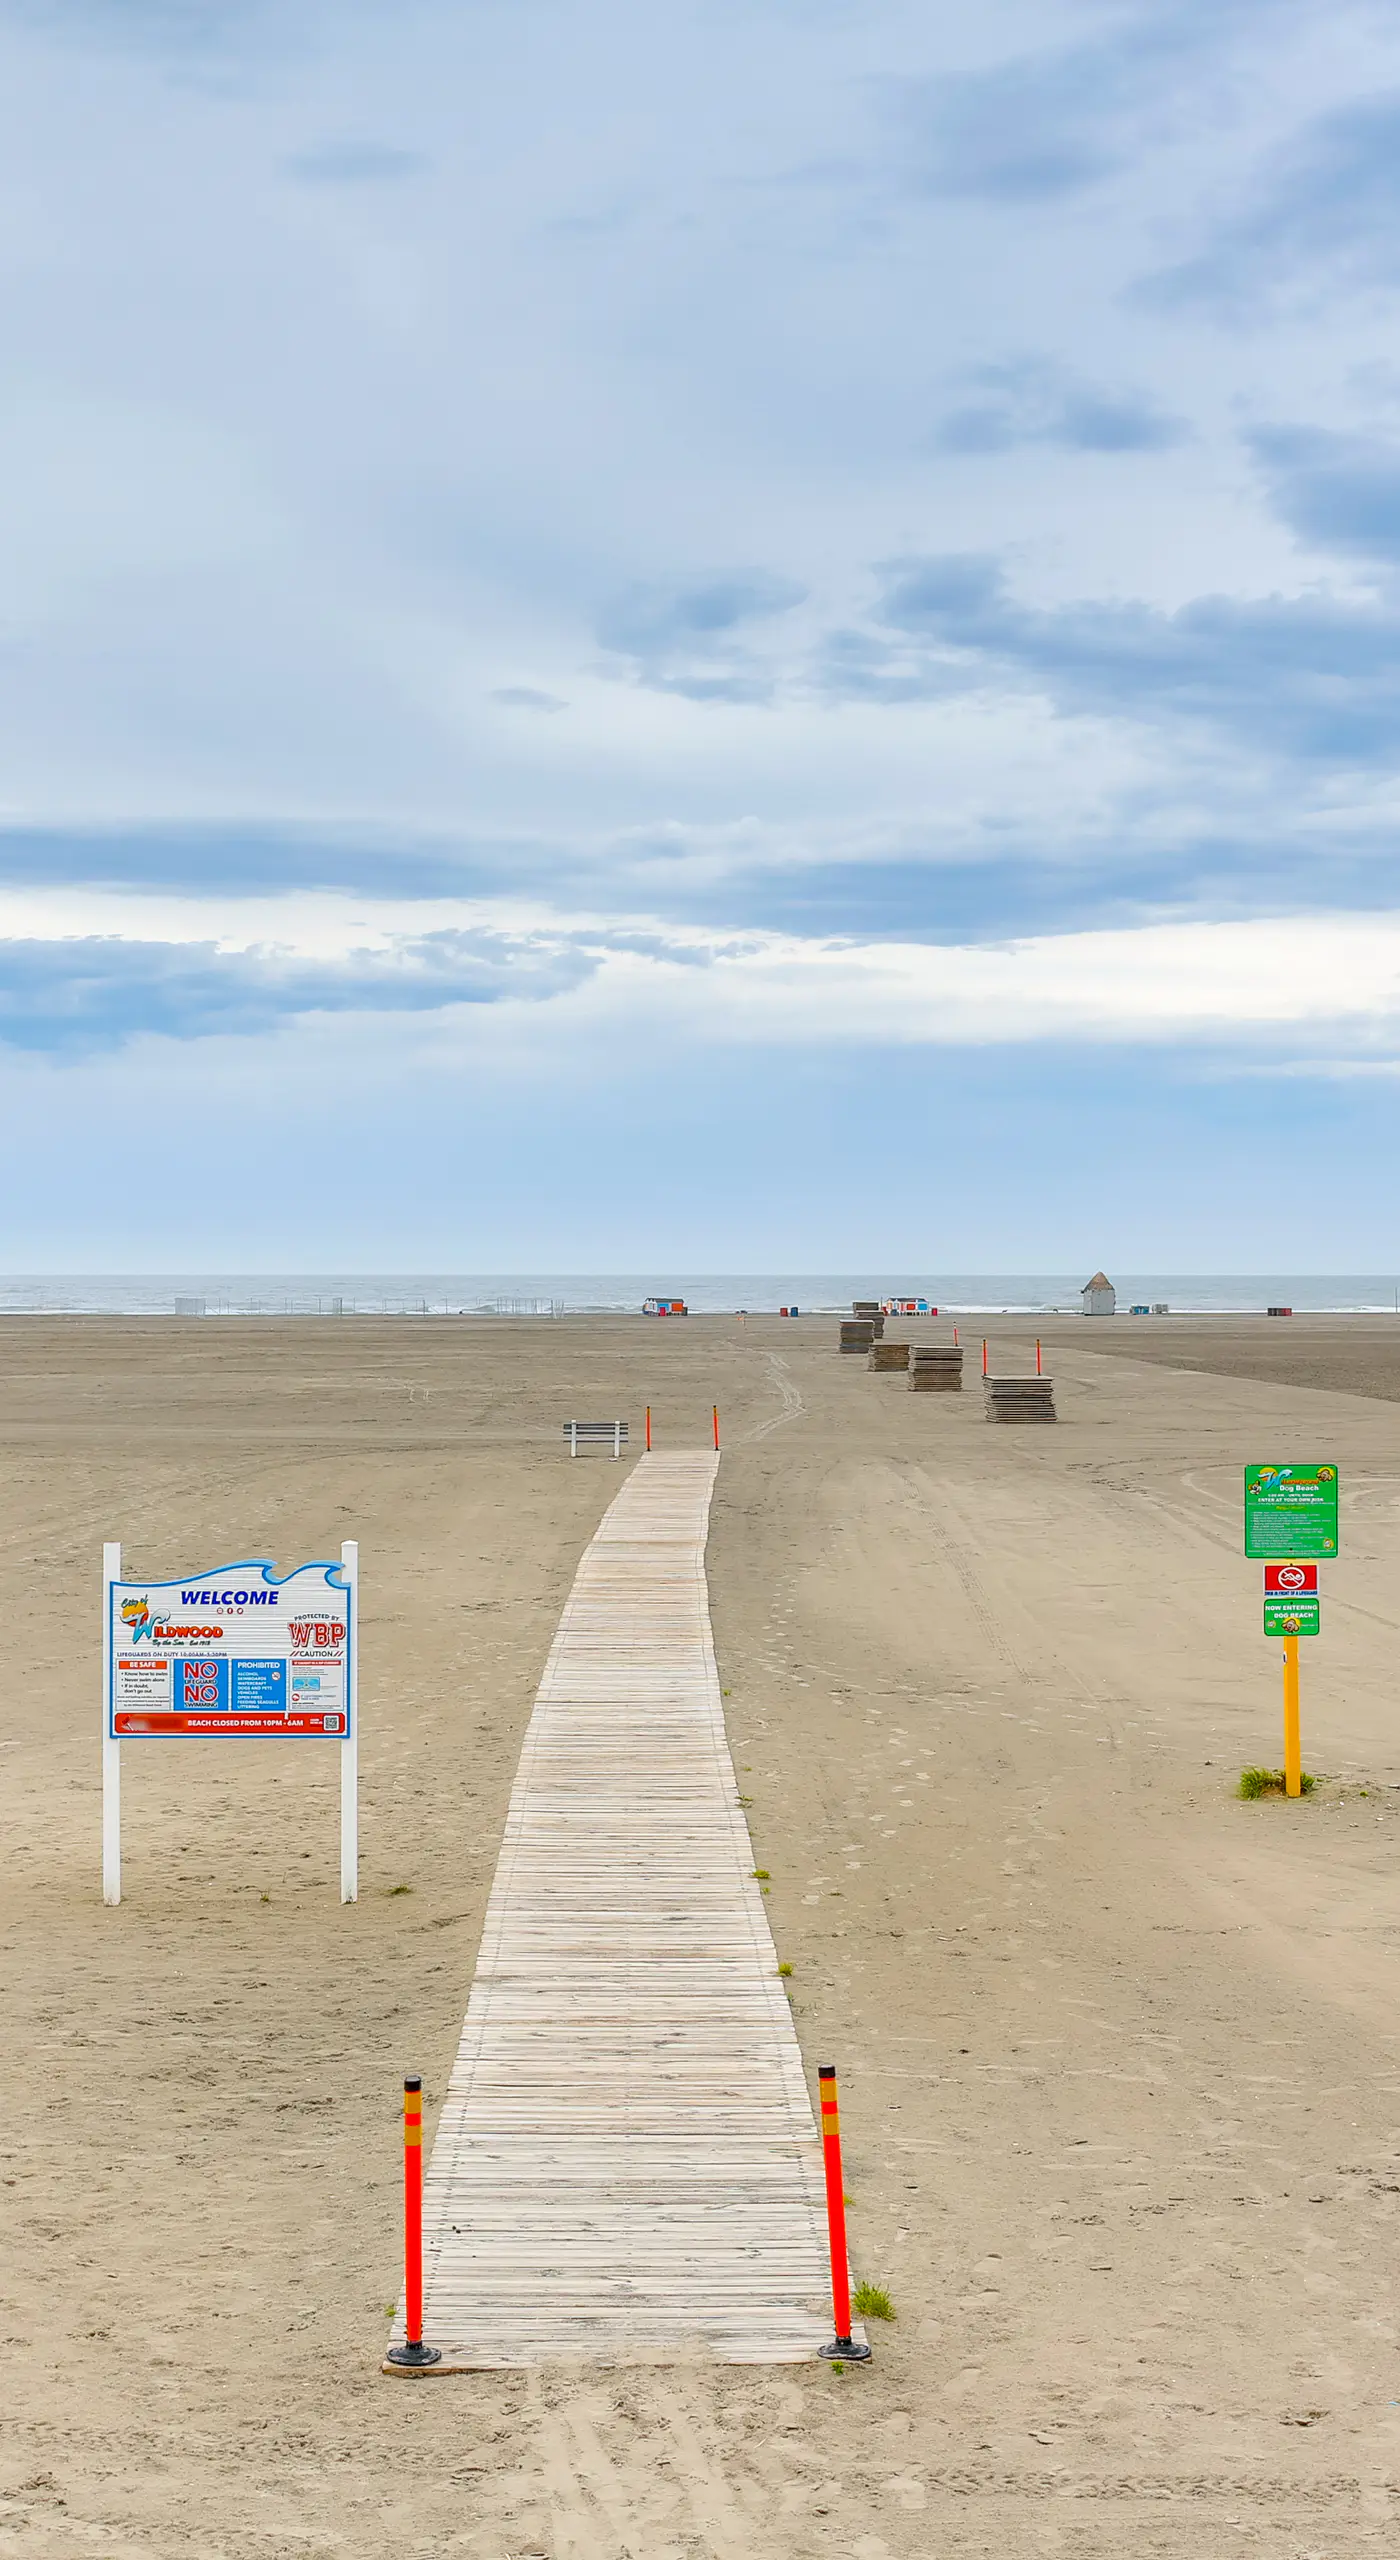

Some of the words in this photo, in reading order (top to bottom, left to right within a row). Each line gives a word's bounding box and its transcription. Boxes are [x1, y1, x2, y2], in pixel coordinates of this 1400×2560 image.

[181, 1591, 279, 1605] WELCOME
[294, 1613, 330, 1621] PROTECTED
[121, 1608, 223, 1645] WILDWOOD
[288, 1622, 346, 1648] WBP
[184, 1661, 218, 1679] NO
[184, 1684, 218, 1702] NO
